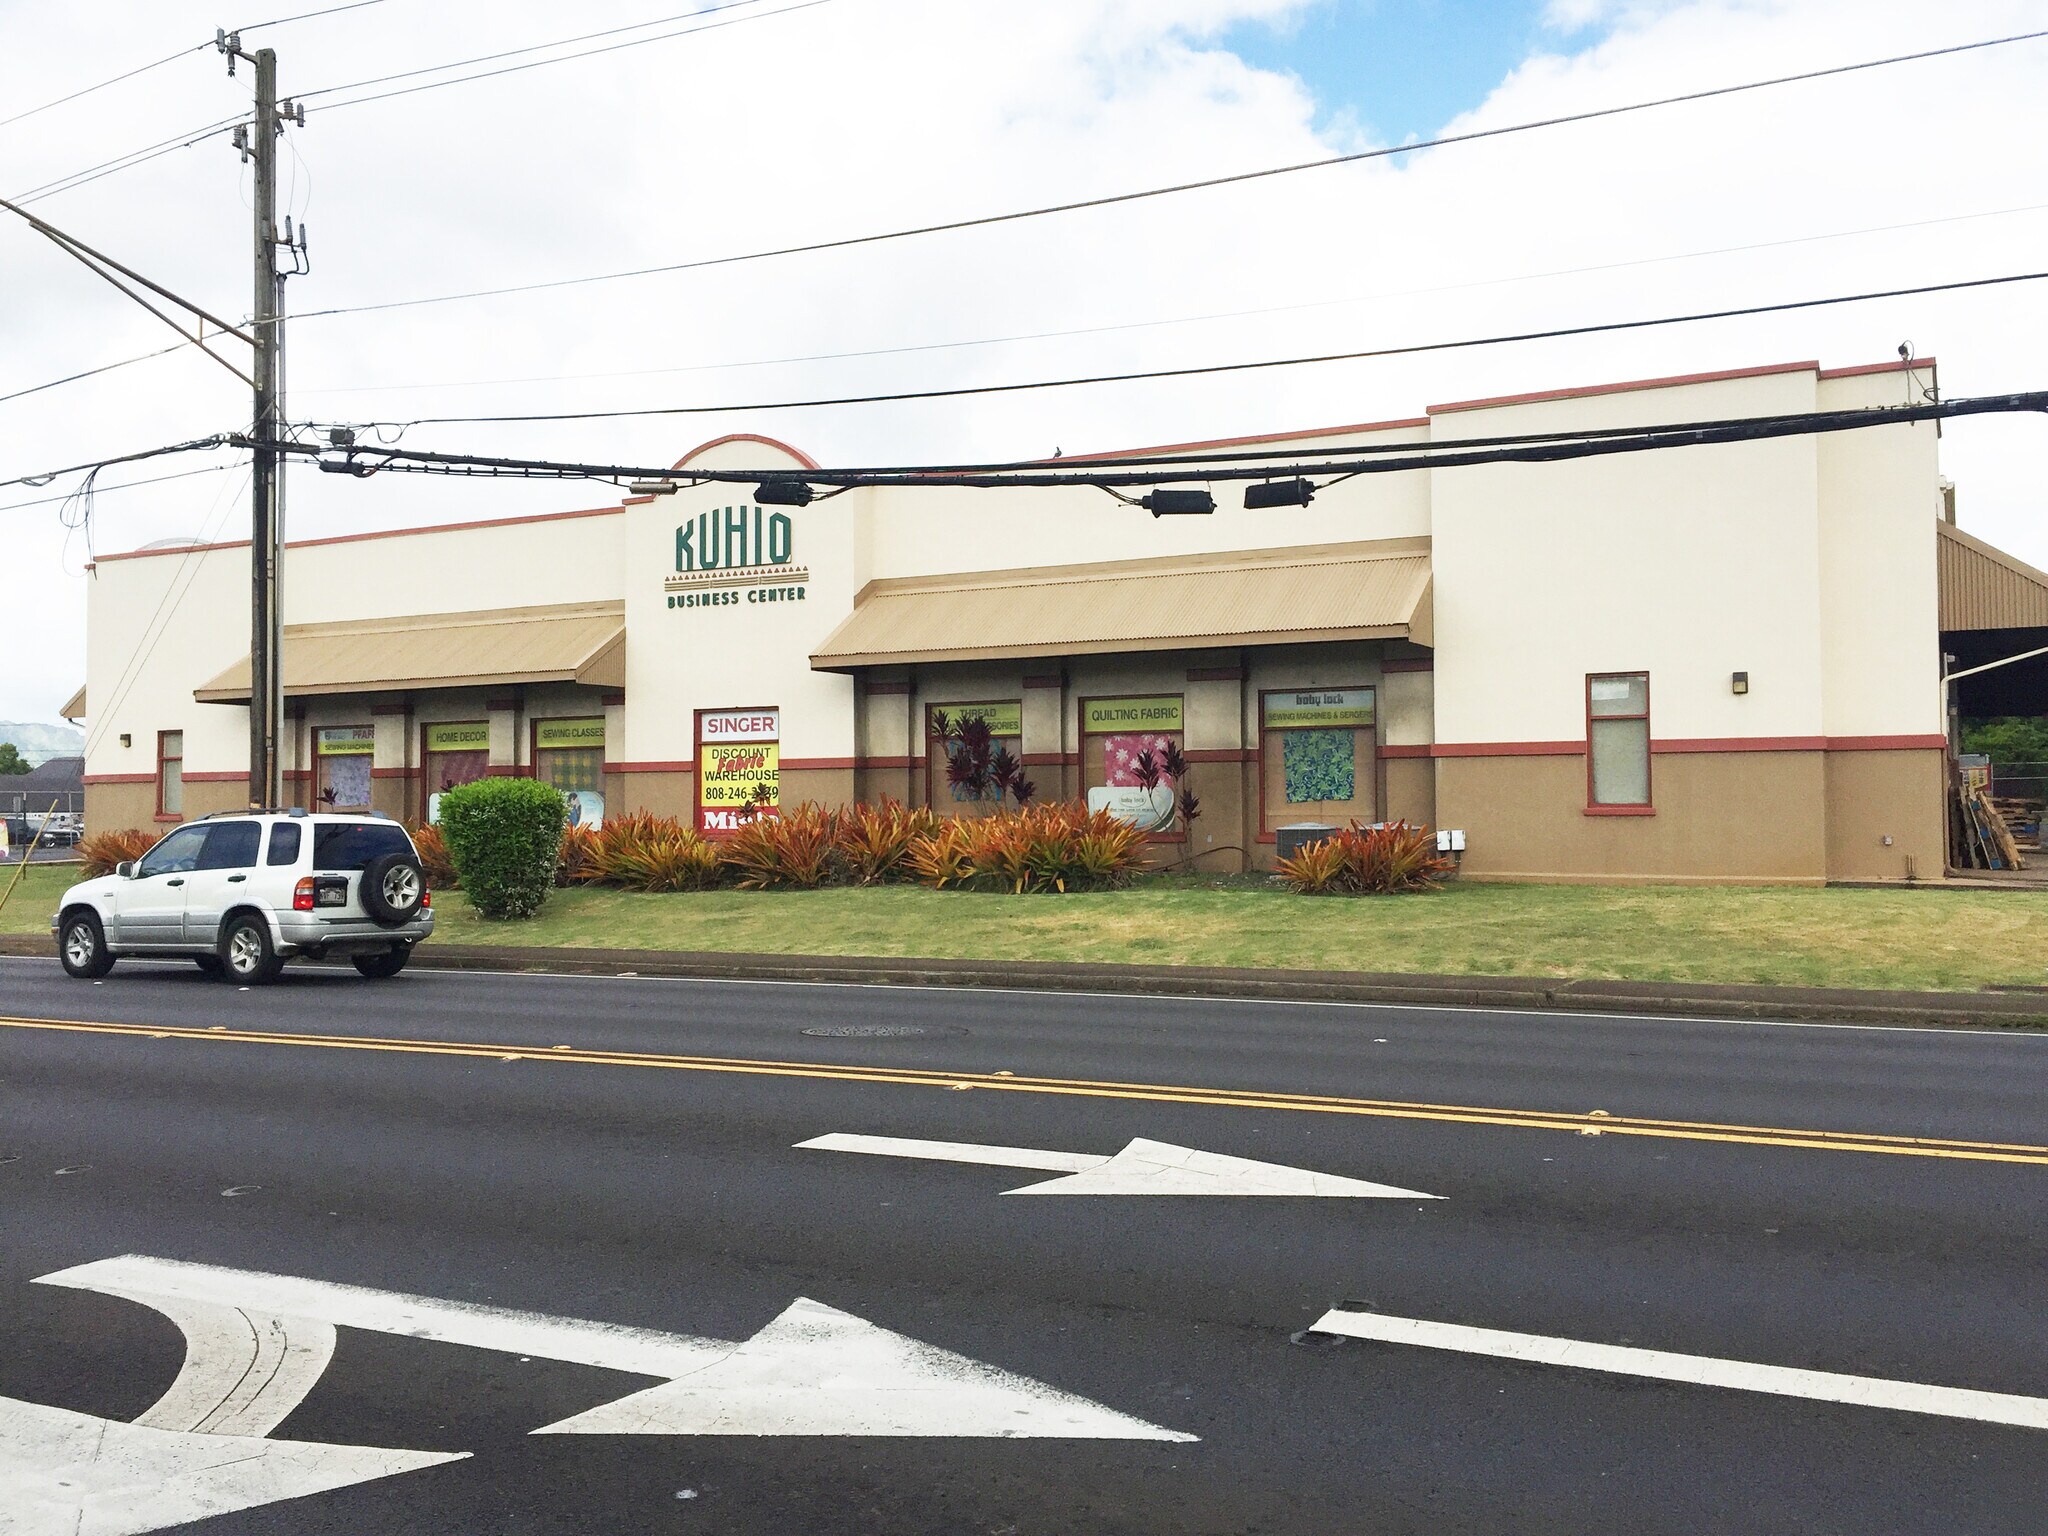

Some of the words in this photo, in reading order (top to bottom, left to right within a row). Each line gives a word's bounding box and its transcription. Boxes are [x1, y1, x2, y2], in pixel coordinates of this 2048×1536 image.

[676, 505, 792, 572] KUHIO
[667, 591, 739, 609] BUSINESS
[747, 586, 806, 603] CENTER
[1296, 693, 1321, 707] baby
[1323, 693, 1344, 704] lock
[960, 708, 997, 718] THREAD
[1092, 708, 1138, 721] QUILTING
[1140, 707, 1178, 719] FABRIC
[1268, 712, 1295, 721] SEWING
[1296, 711, 1332, 720] MACHINES
[1333, 711, 1338, 719] &
[707, 716, 775, 733] SINGER
[436, 732, 459, 742] HOME
[460, 731, 487, 742] DECOR
[542, 728, 570, 739] SEWING
[571, 727, 605, 738] CLASSES
[711, 747, 772, 760] DISCOUNT
[717, 751, 766, 774] Fabric
[704, 769, 779, 781] WAREHOUSE
[705, 786, 779, 800] 808-246-239
